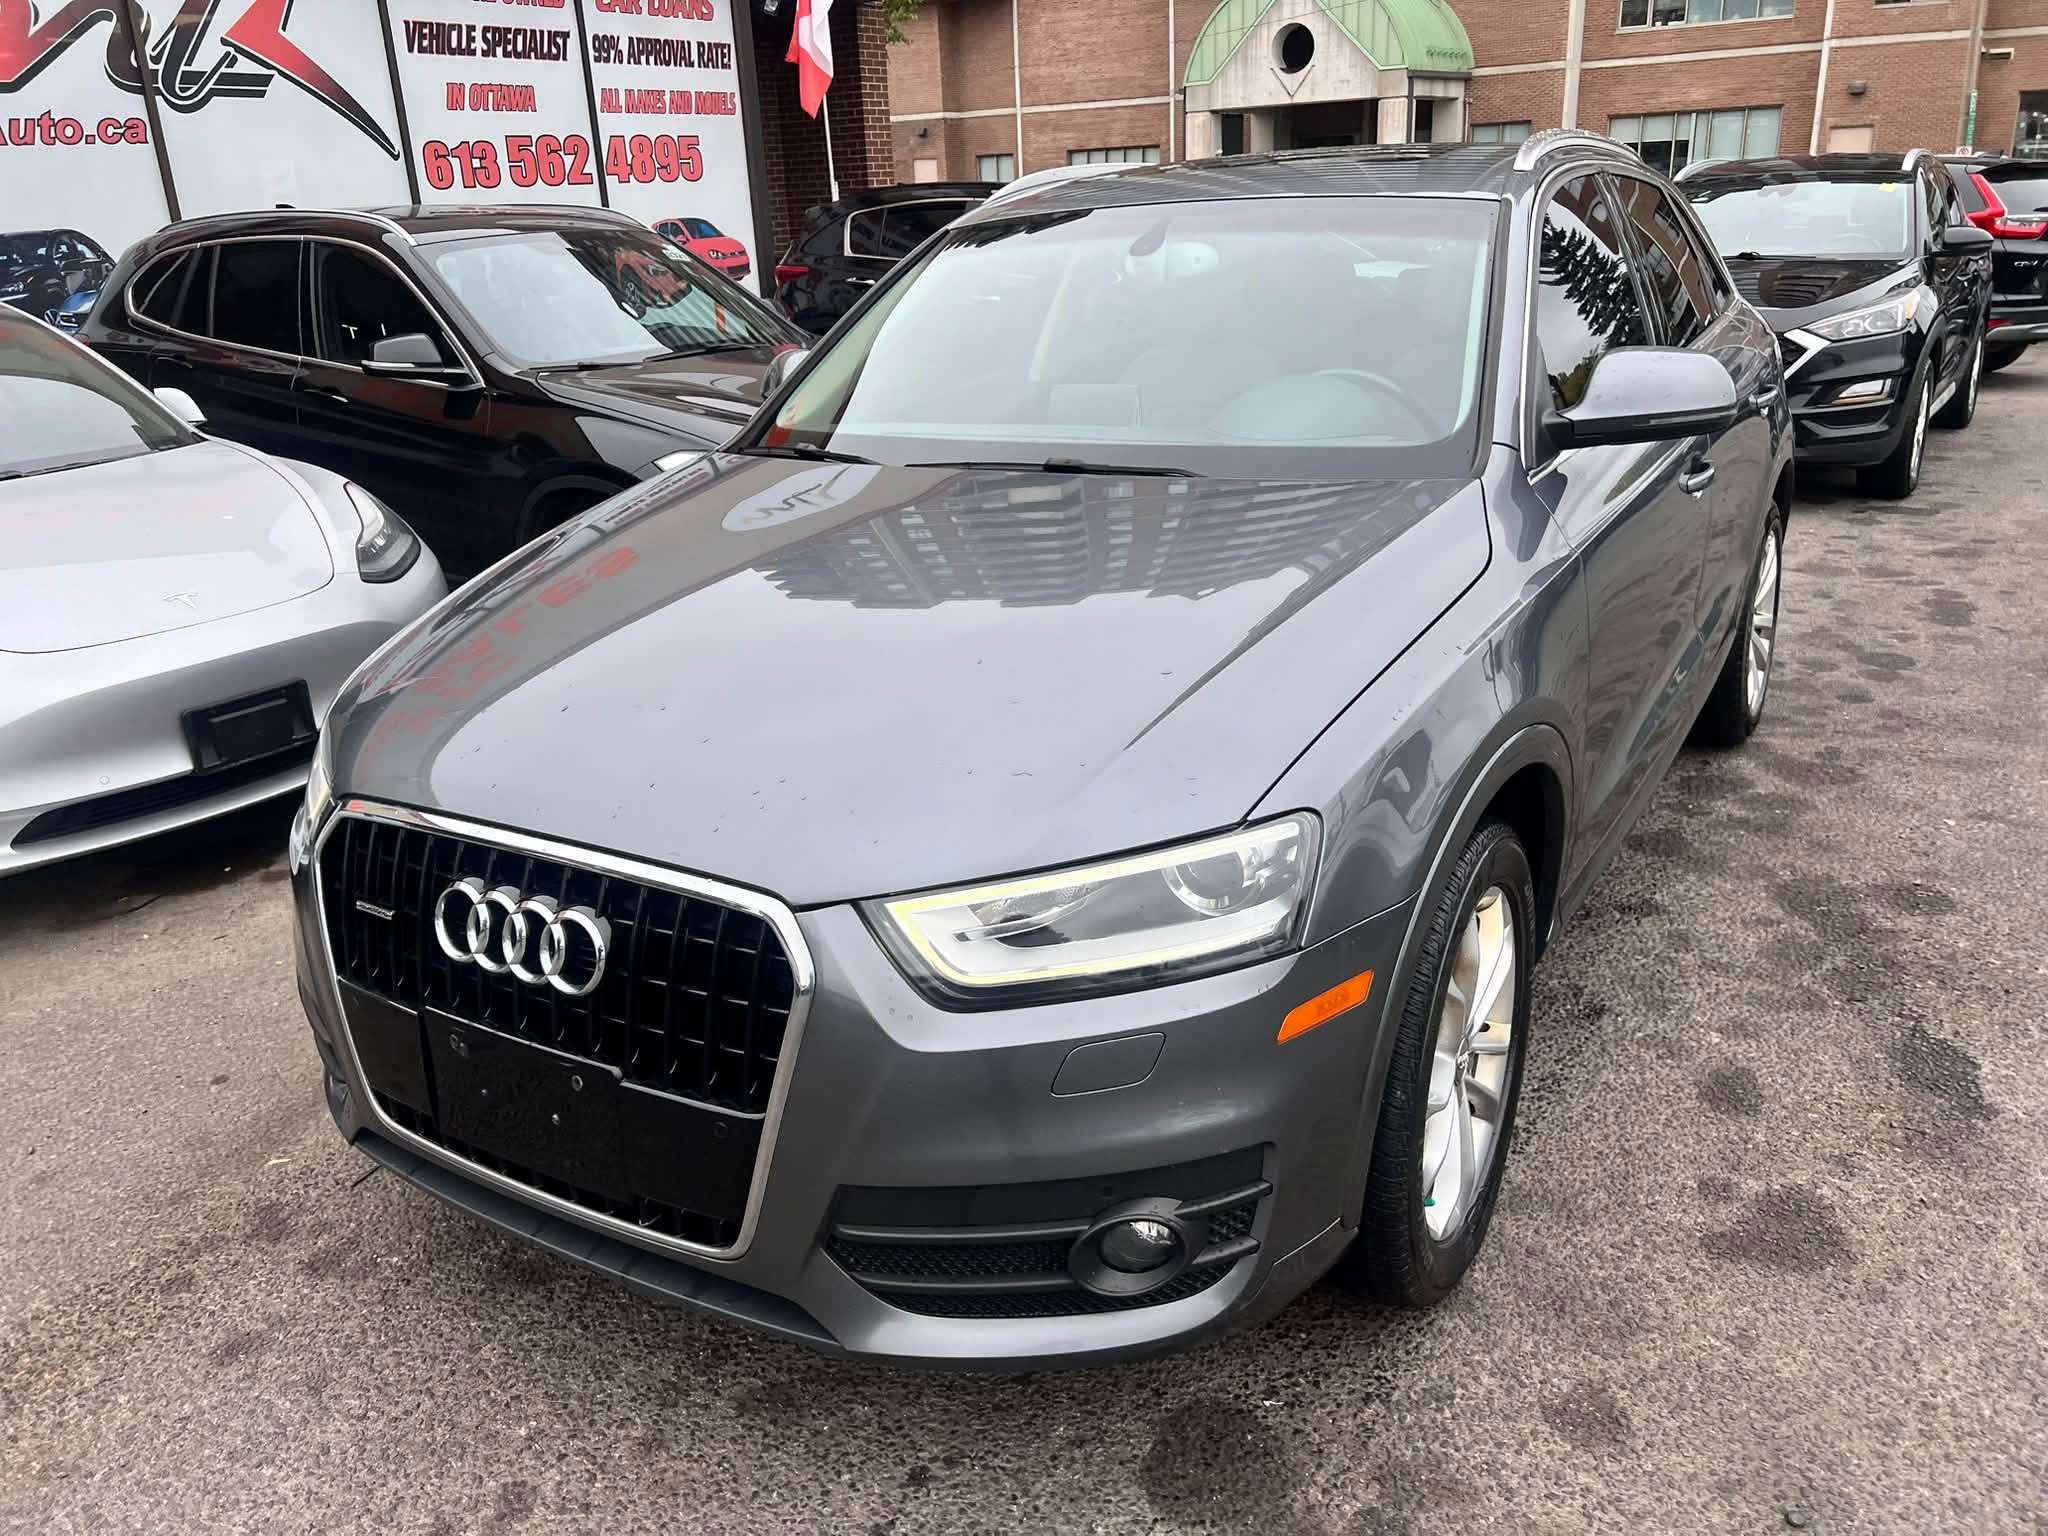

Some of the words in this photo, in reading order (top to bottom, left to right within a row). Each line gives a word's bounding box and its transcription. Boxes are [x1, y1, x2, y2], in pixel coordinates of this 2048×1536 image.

[403, 20, 476, 56] VEHICLE
[481, 26, 570, 61] SPECIALIST
[592, 34, 623, 64] 99%
[627, 36, 694, 68] APPROVAL
[696, 41, 732, 70] RATE!
[446, 82, 466, 111] IN
[469, 83, 537, 112] OTTAWA
[600, 88, 622, 113] ALL
[625, 89, 666, 114] MAKES
[669, 91, 692, 114] AND
[695, 91, 736, 115] MODELS
[423, 140, 500, 190] 613
[505, 134, 593, 187] 562
[606, 134, 703, 183] 4895
